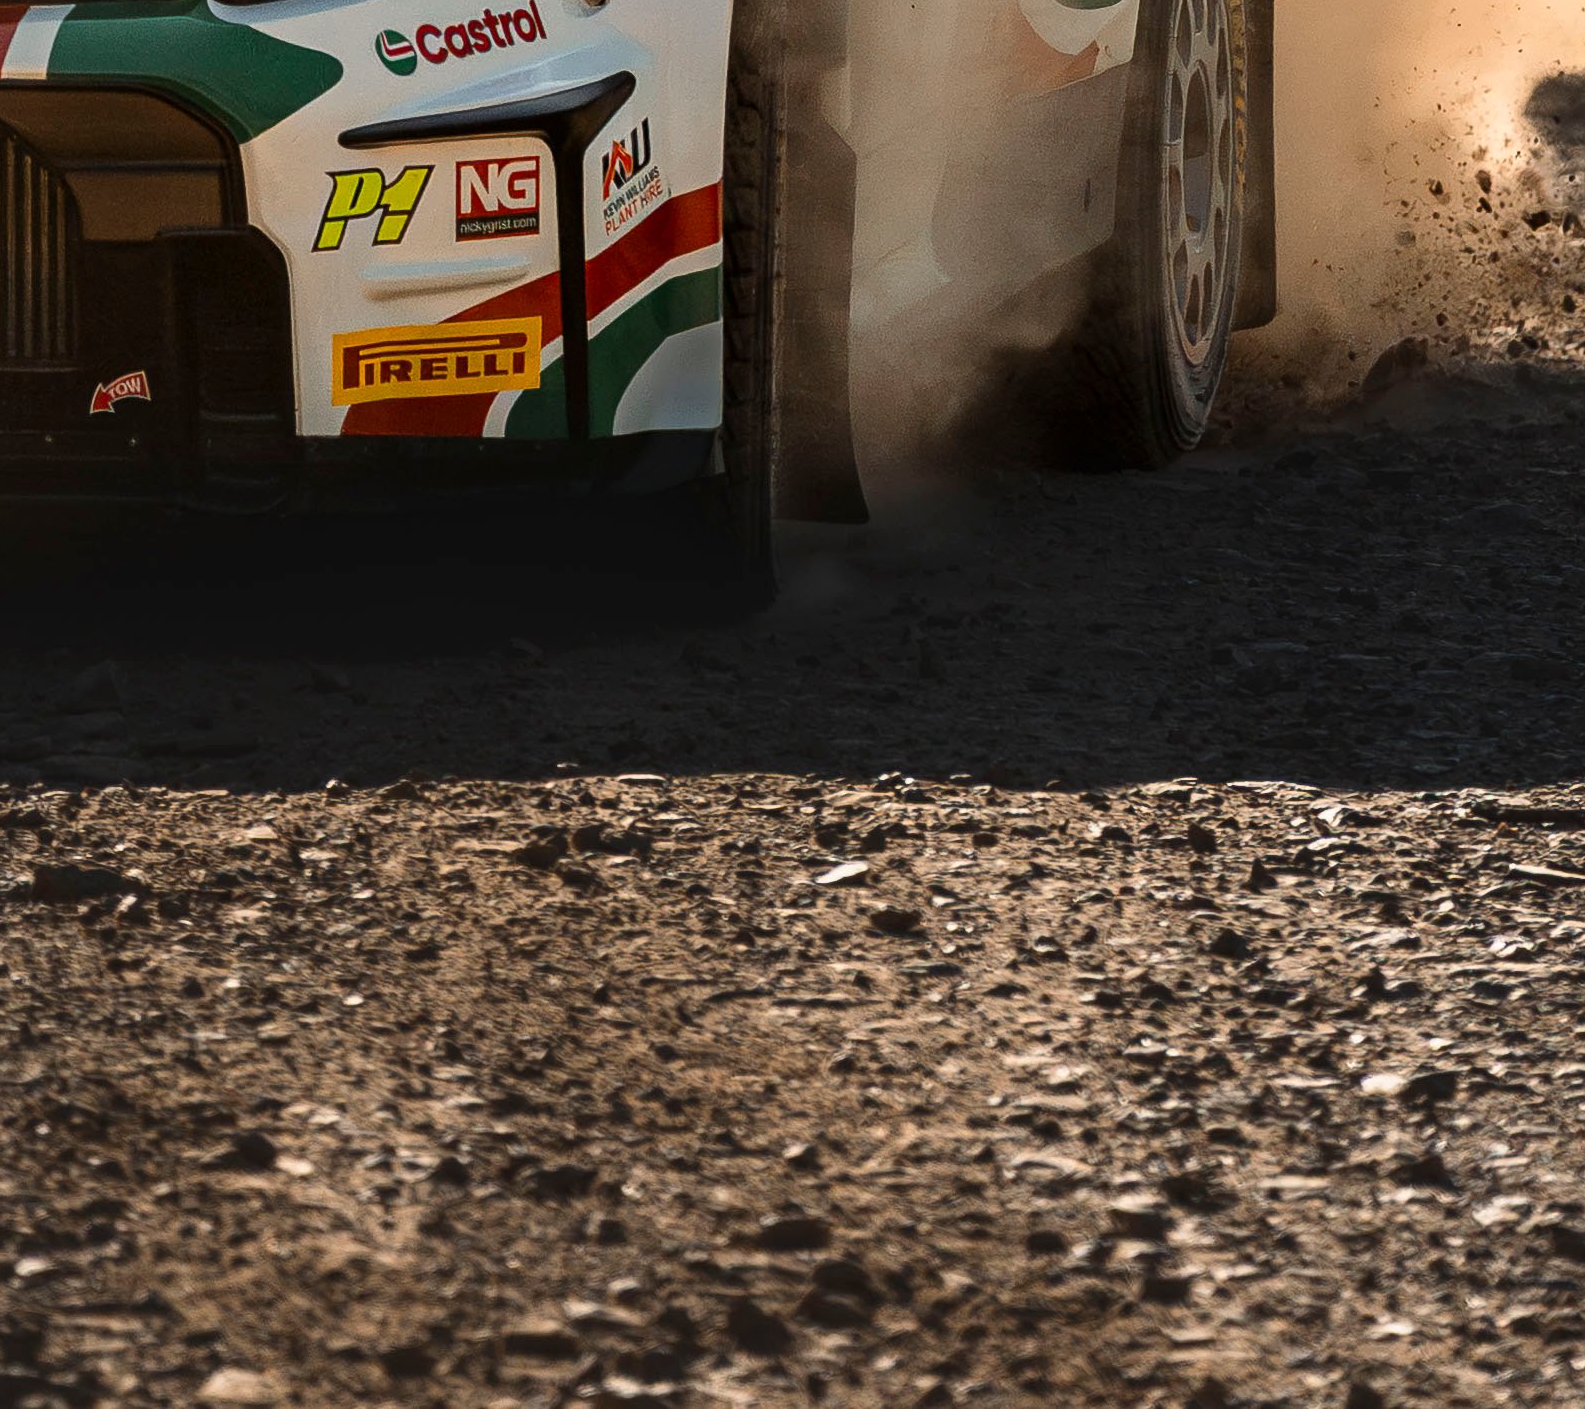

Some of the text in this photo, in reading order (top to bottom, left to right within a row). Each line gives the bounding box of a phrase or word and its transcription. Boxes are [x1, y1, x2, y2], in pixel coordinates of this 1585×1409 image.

[415, 0, 547, 65] Castrol
[311, 165, 436, 253] P1
[459, 159, 537, 214] NG
[605, 178, 664, 237] PLANT HIRE
[109, 377, 141, 398] TOW
[342, 331, 528, 390] PIRELLI
